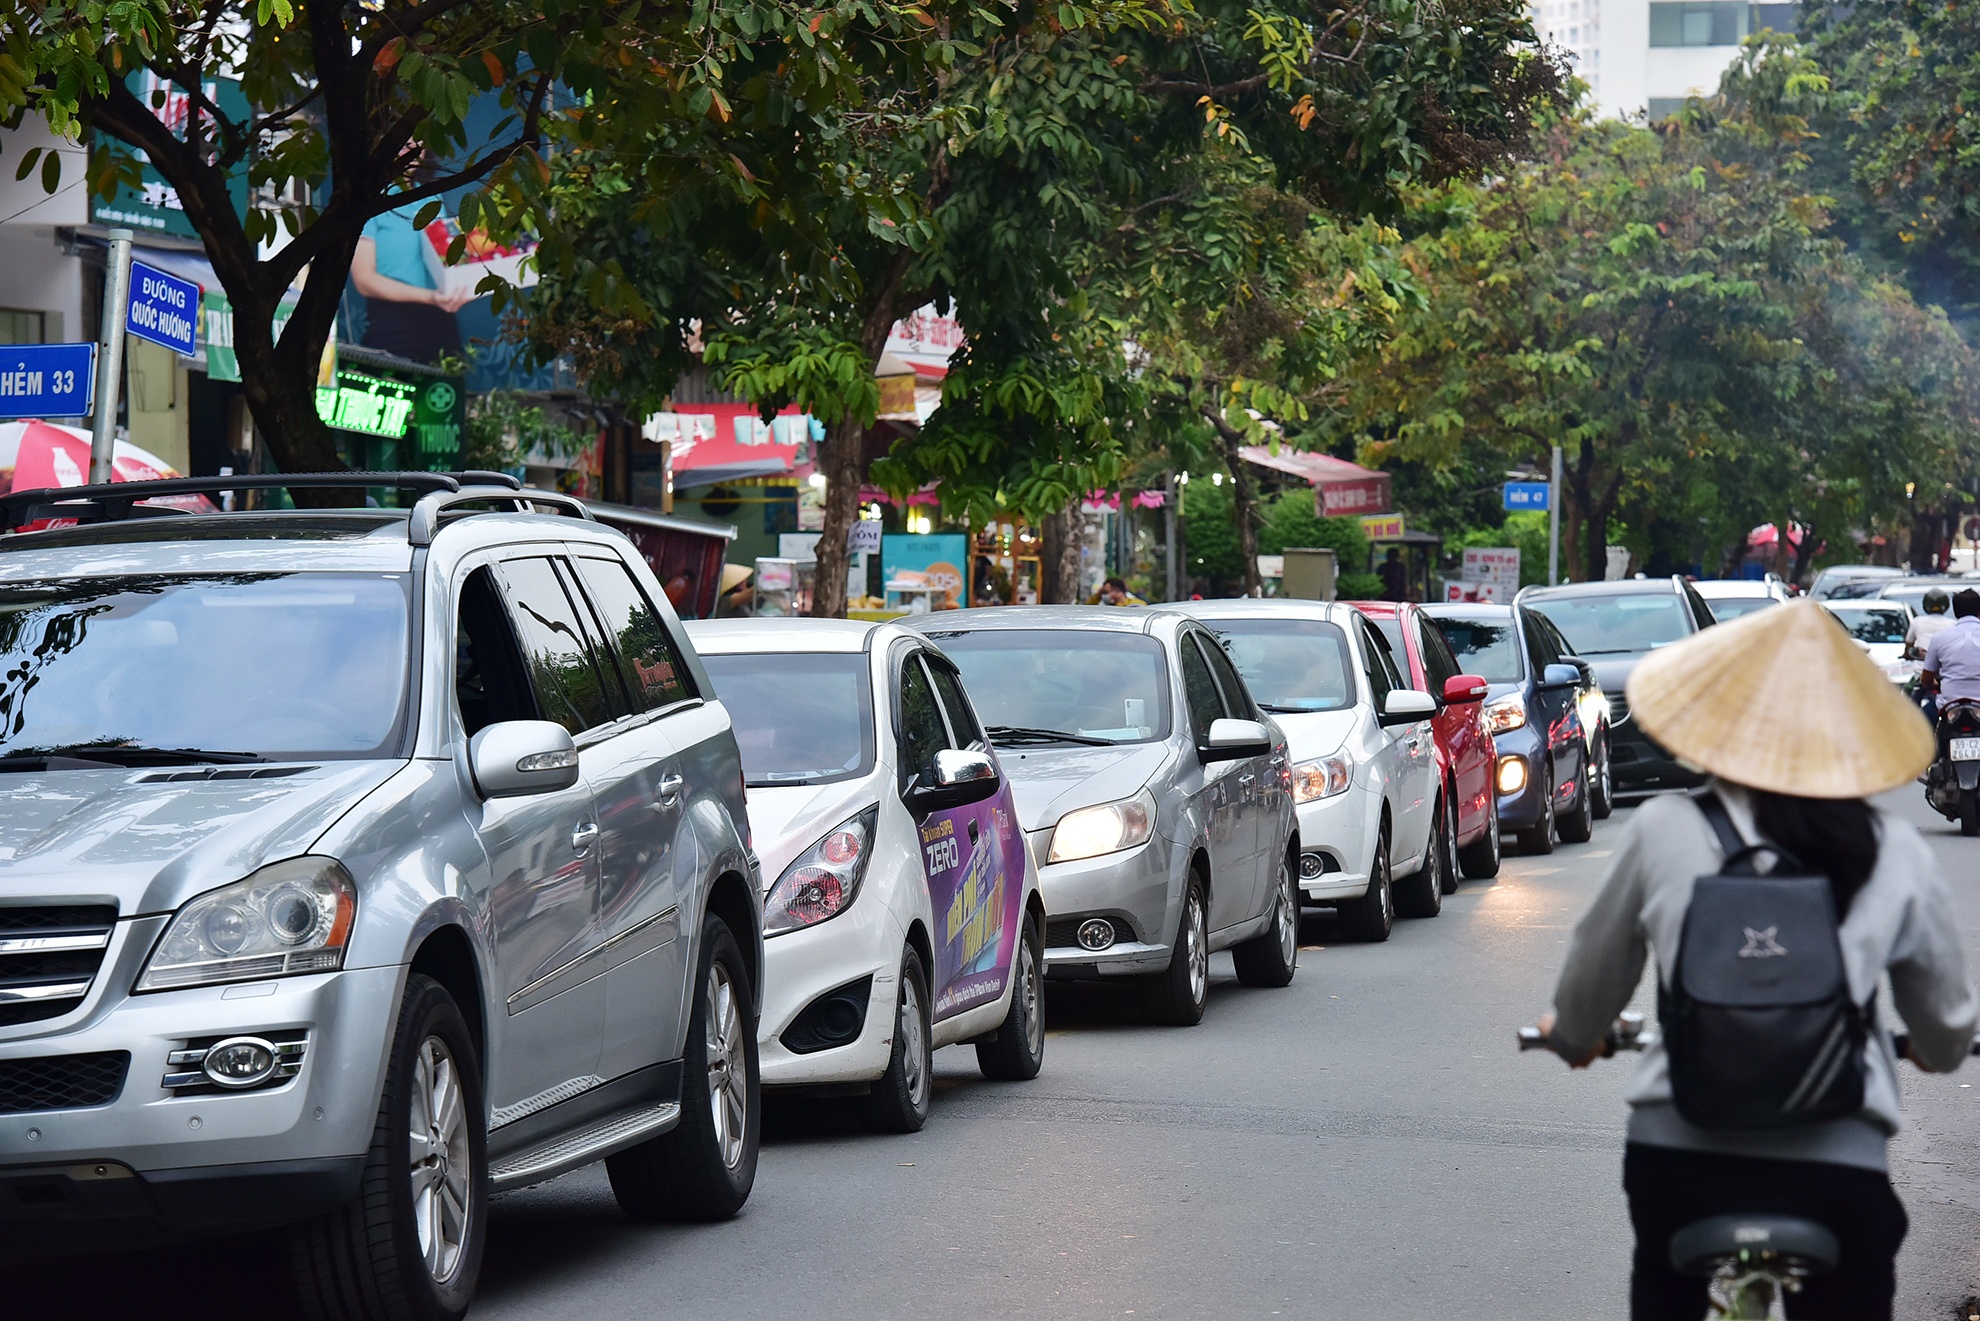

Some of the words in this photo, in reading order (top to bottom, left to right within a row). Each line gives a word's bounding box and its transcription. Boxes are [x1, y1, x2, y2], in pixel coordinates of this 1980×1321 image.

[142, 276, 186, 309] ĐƯỜNG
[131, 299, 158, 330] QUỐC
[157, 310, 192, 344] HƯƠNG
[0, 362, 43, 396] HẺM
[52, 370, 74, 394] 33
[420, 413, 461, 453] THUỐC
[940, 818, 955, 837] SUPER
[926, 836, 959, 877] ZERO
